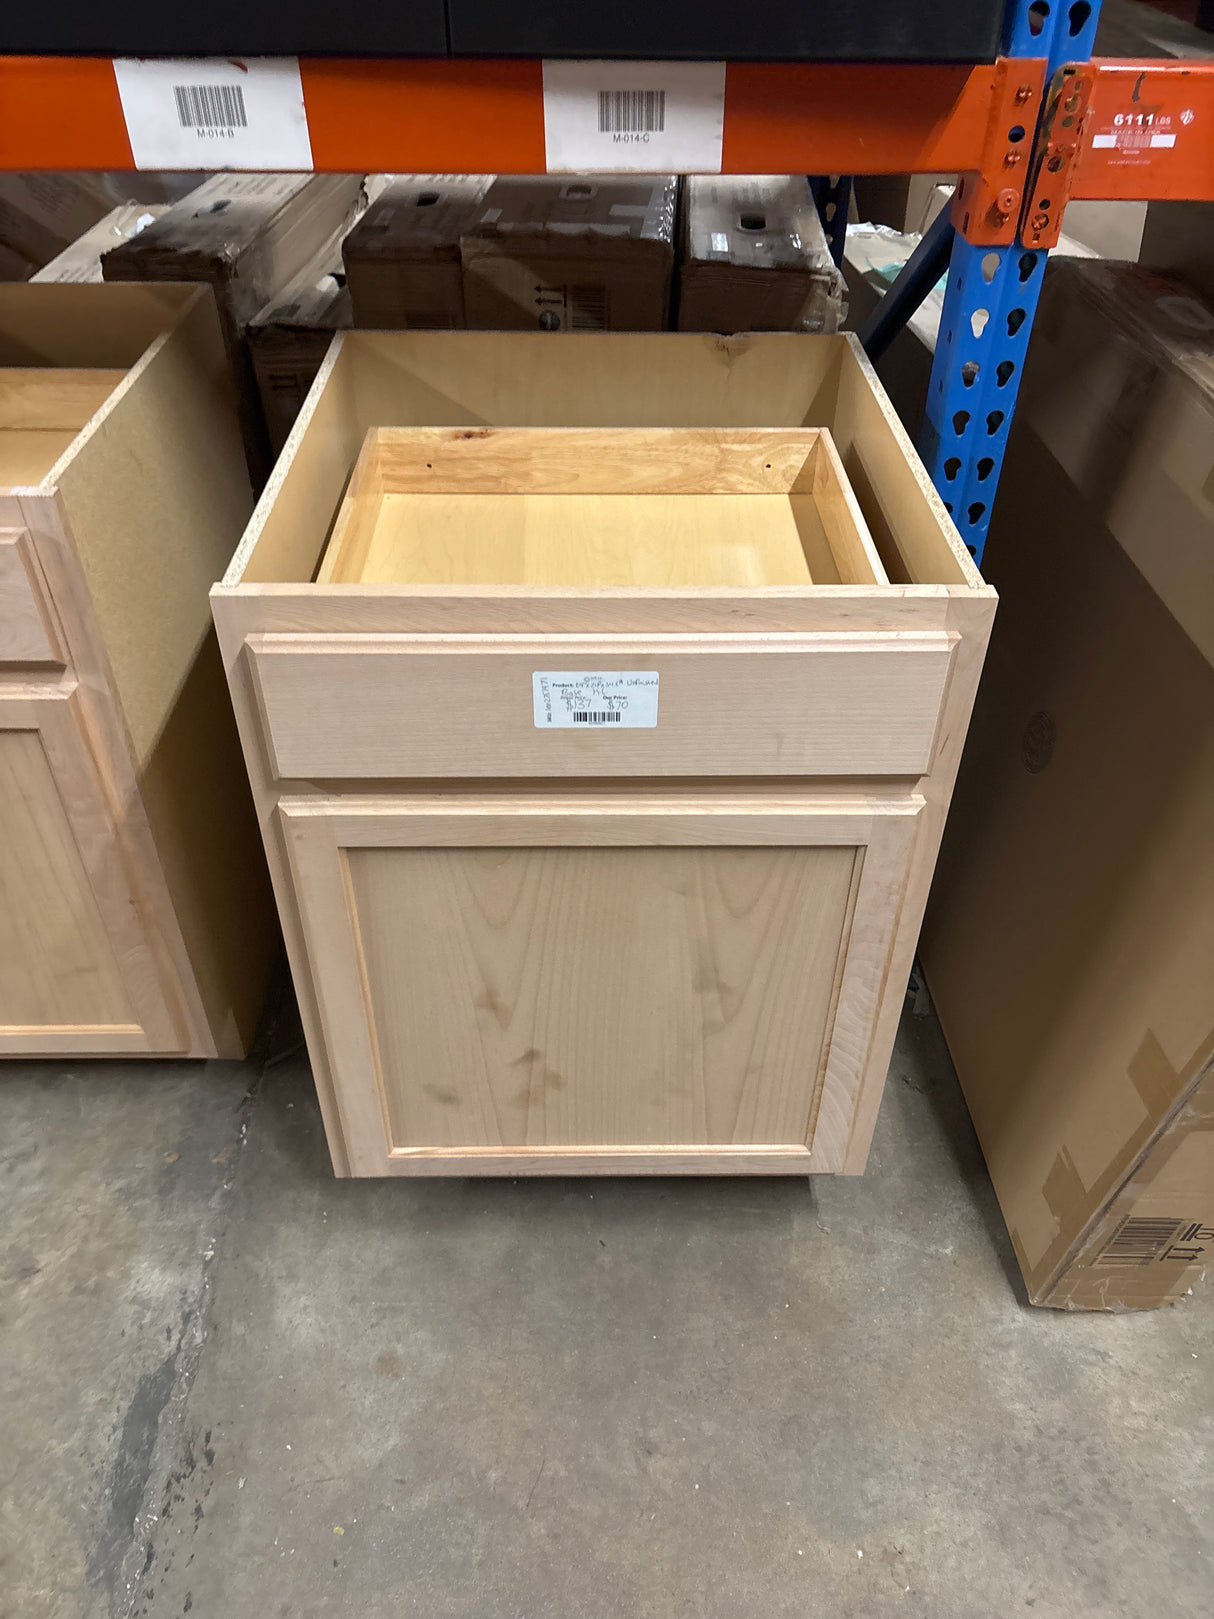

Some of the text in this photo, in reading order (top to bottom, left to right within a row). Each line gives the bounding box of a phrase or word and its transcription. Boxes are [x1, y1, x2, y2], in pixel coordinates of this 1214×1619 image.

[1114, 113, 1154, 126] 6111
[197, 129, 235, 138] M-014-B
[613, 133, 650, 144] M-014-C
